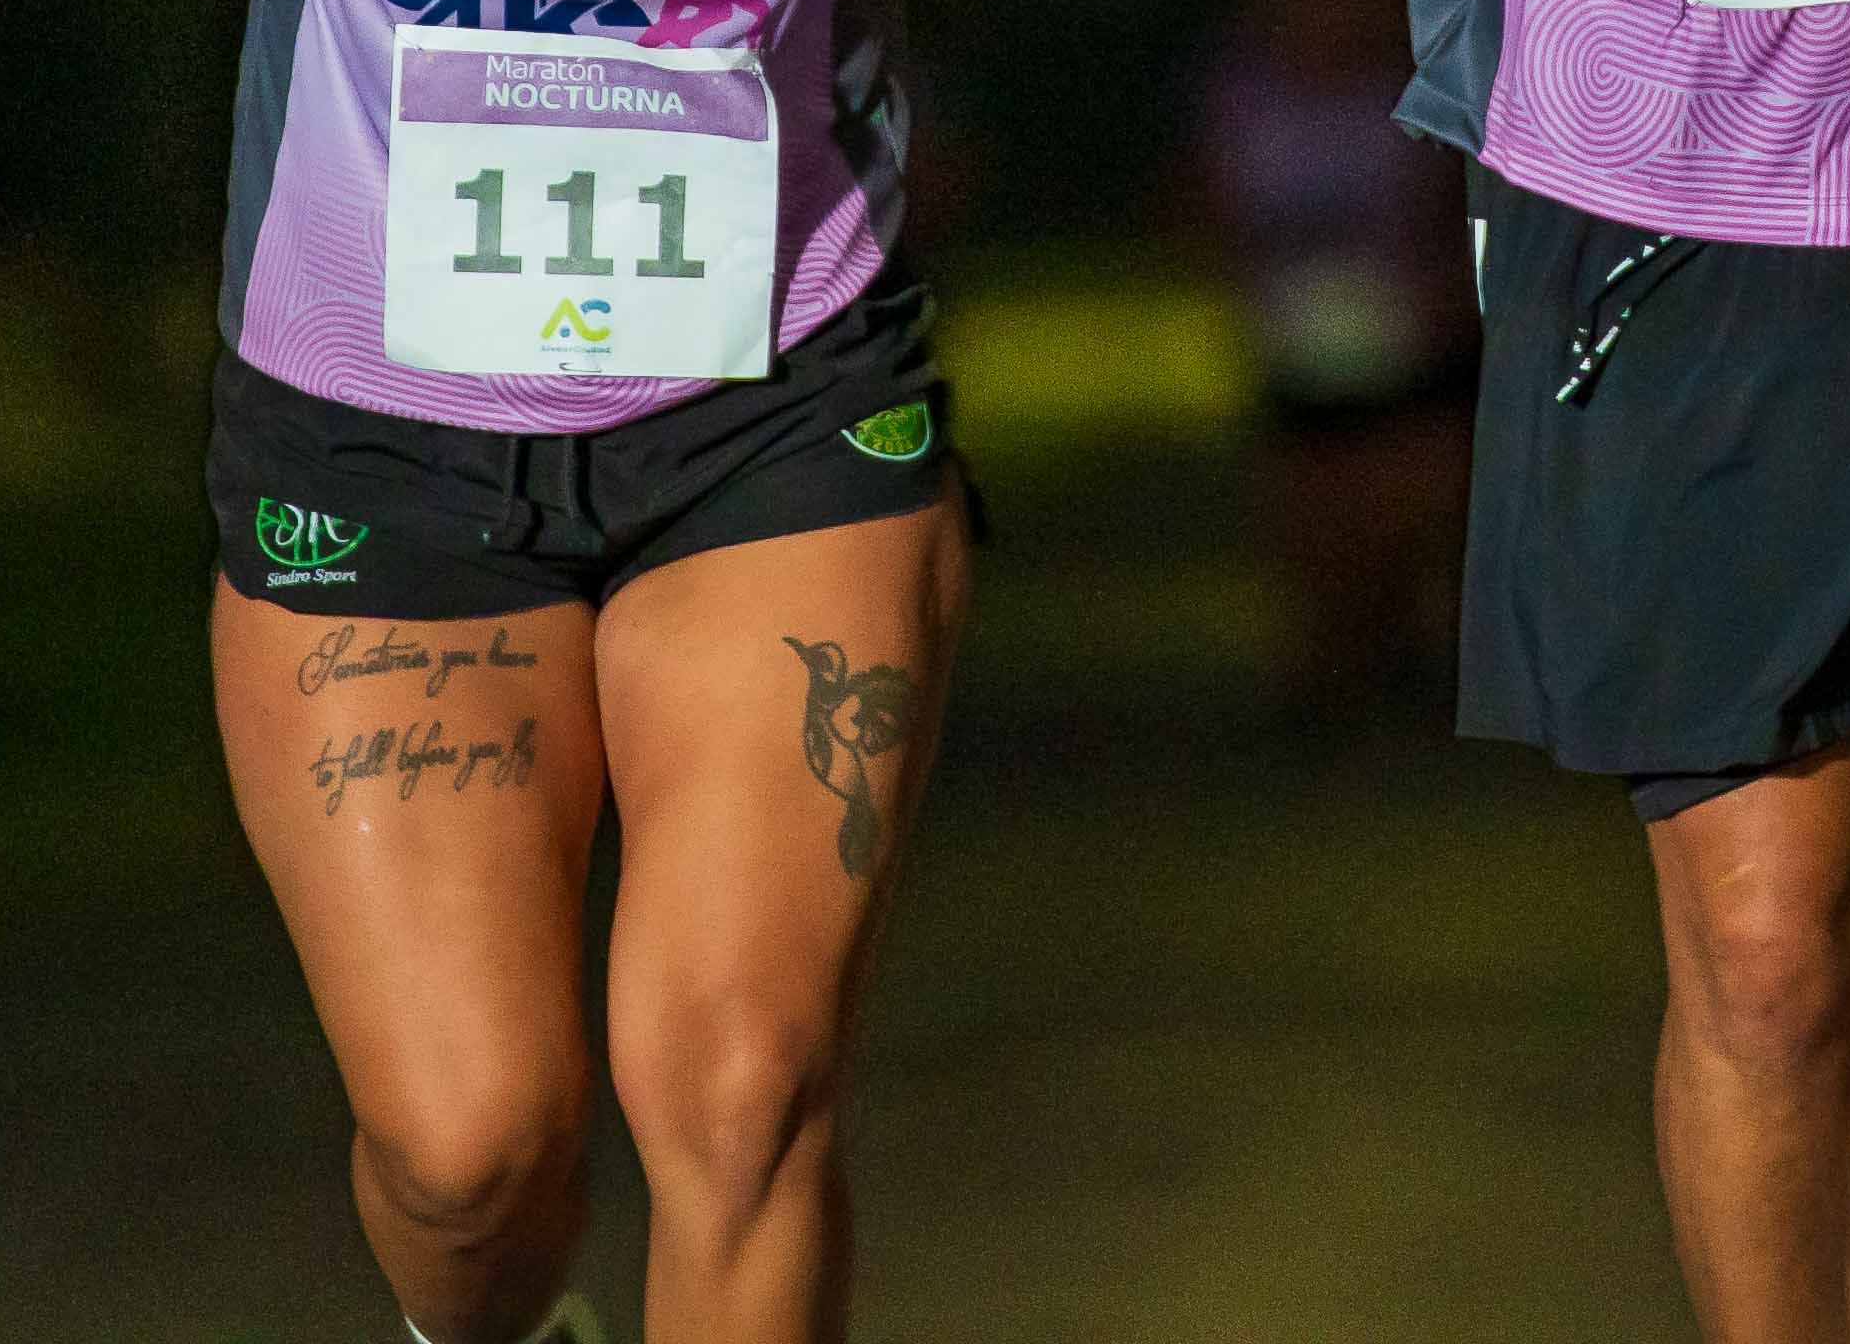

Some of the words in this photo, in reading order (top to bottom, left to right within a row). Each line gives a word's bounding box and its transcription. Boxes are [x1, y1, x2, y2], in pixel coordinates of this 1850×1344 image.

[486, 54, 605, 82] Maratón
[484, 82, 685, 116] NOCTURNA
[453, 168, 705, 279] 111
[266, 569, 311, 587] Sindro
[312, 568, 357, 585] Sport
